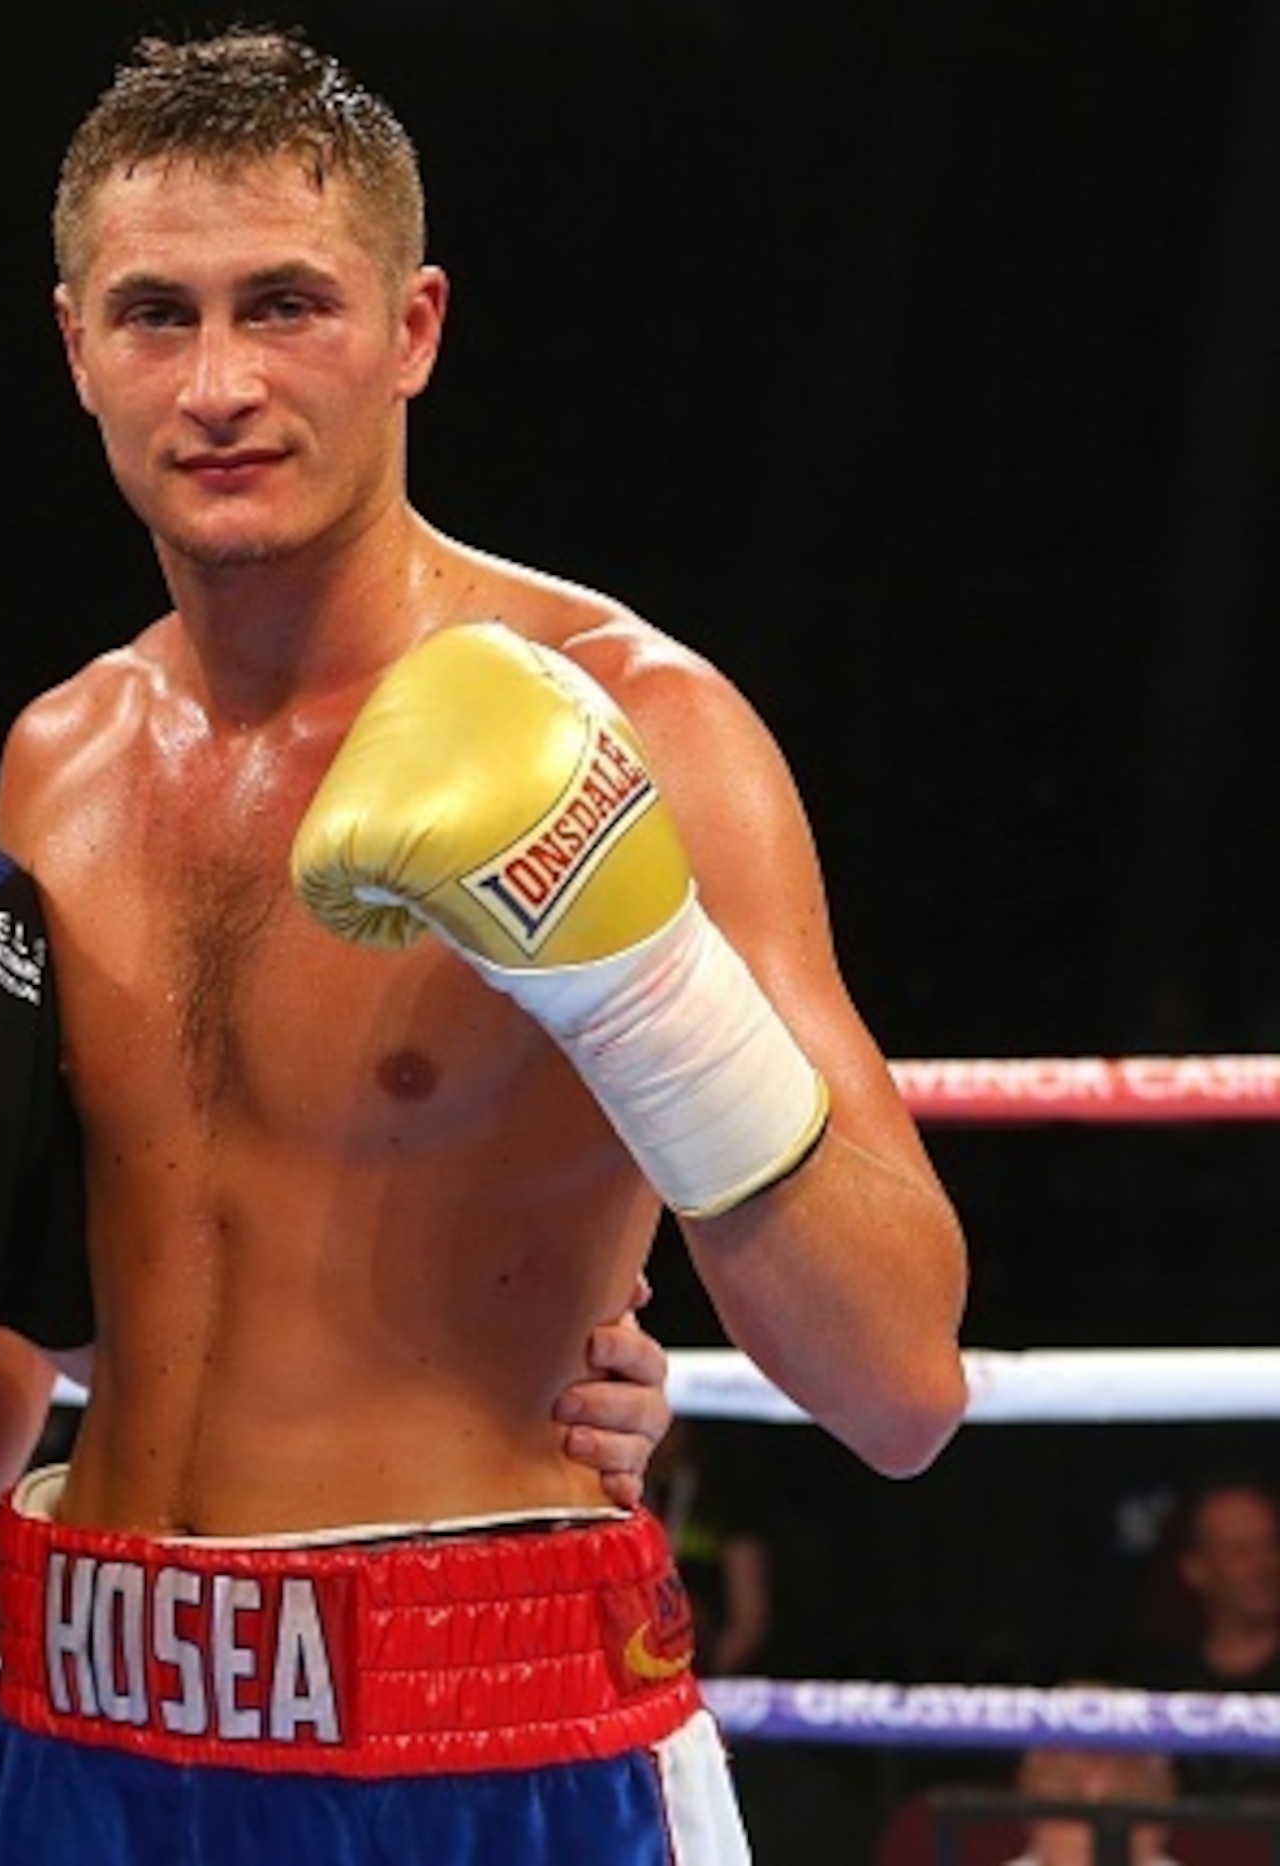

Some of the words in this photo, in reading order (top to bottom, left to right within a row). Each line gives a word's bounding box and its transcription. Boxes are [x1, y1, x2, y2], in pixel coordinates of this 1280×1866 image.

[477, 729, 652, 940] LONSDALE
[45, 1553, 342, 1744] HOSEA
[794, 1680, 1154, 1734] GROSVENOR
